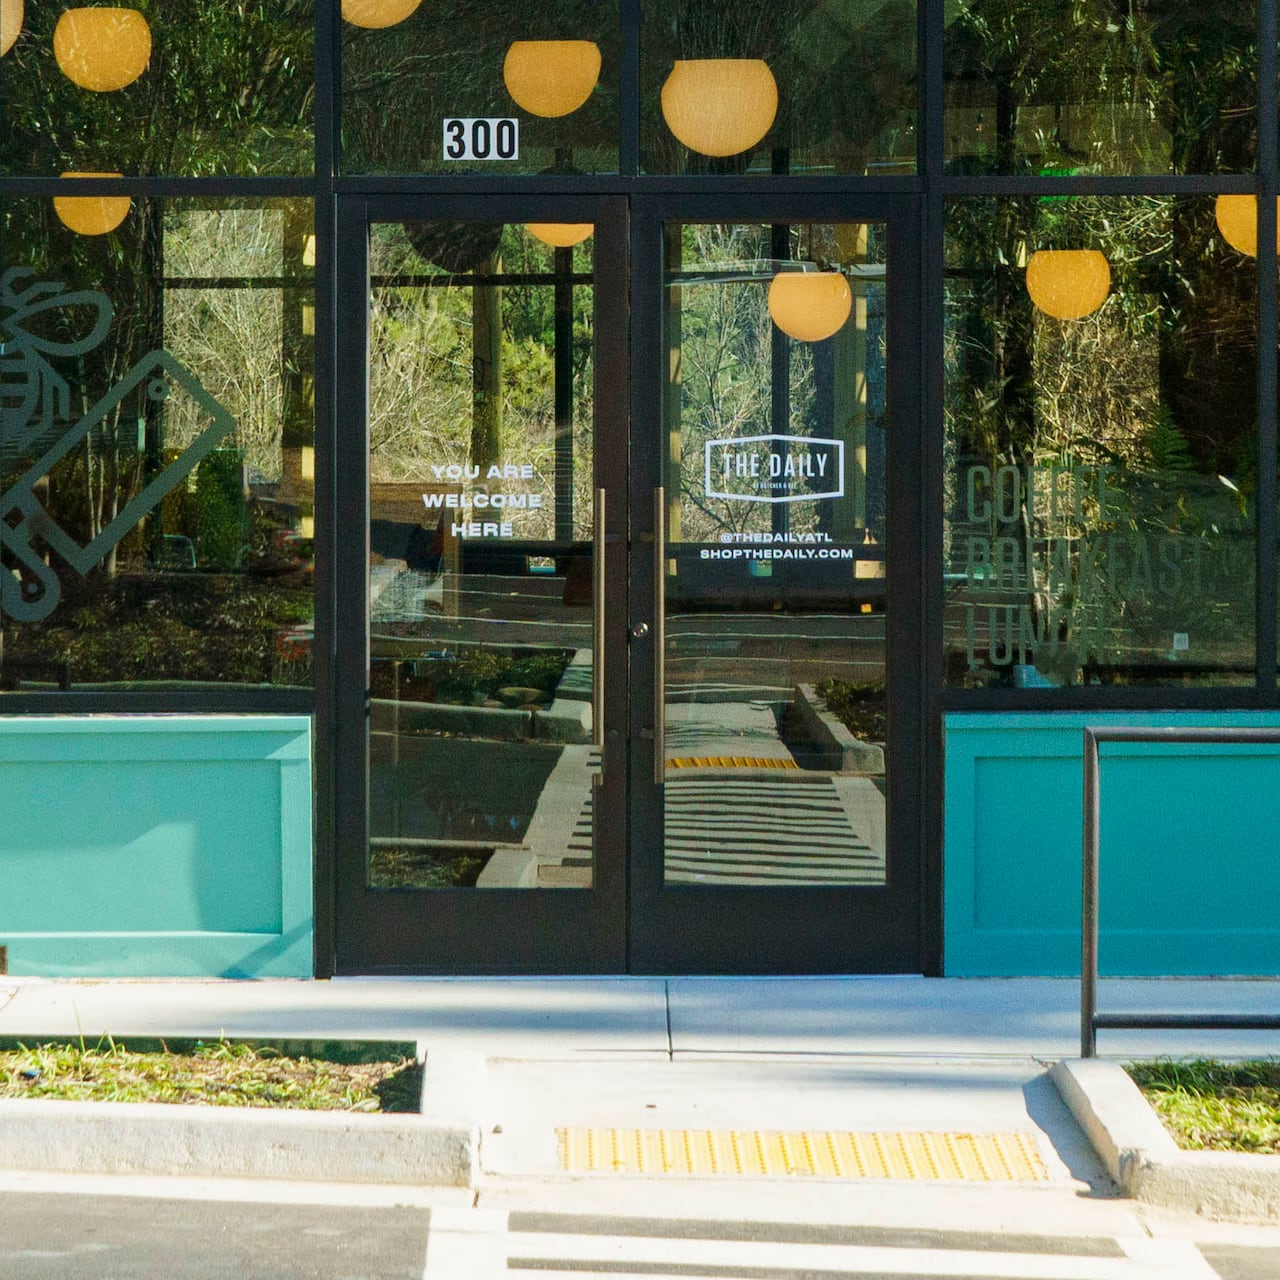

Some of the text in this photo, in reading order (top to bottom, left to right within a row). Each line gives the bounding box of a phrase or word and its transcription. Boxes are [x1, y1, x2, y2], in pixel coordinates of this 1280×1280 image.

[446, 119, 516, 159] 300
[430, 465, 534, 480] YOU ARE
[723, 453, 828, 478] THE DAILY
[422, 493, 542, 508] WELCOME
[966, 464, 1119, 523] COFFEE
[451, 522, 513, 537] HERE
[720, 532, 832, 544] @THEDAILYATL
[700, 548, 853, 559] SHOPTHEDAILY.COM
